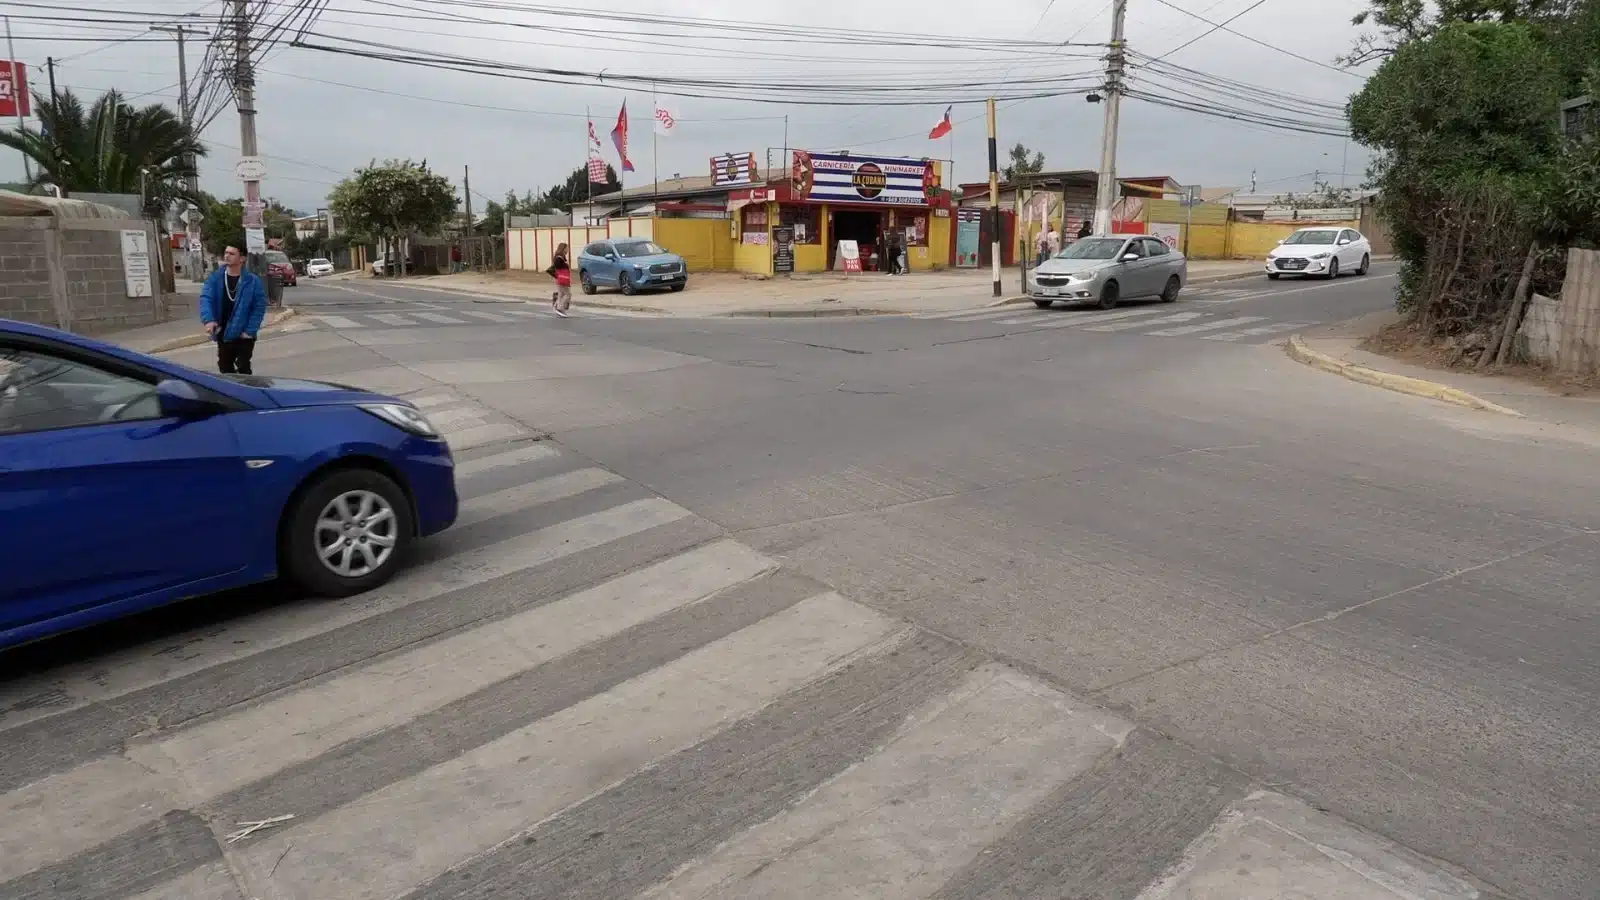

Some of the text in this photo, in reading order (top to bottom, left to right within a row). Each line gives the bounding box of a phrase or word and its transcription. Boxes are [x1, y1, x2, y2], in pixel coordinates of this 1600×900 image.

[884, 165, 924, 174] MINIMARKET
[853, 175, 885, 185] LA CUBANA
